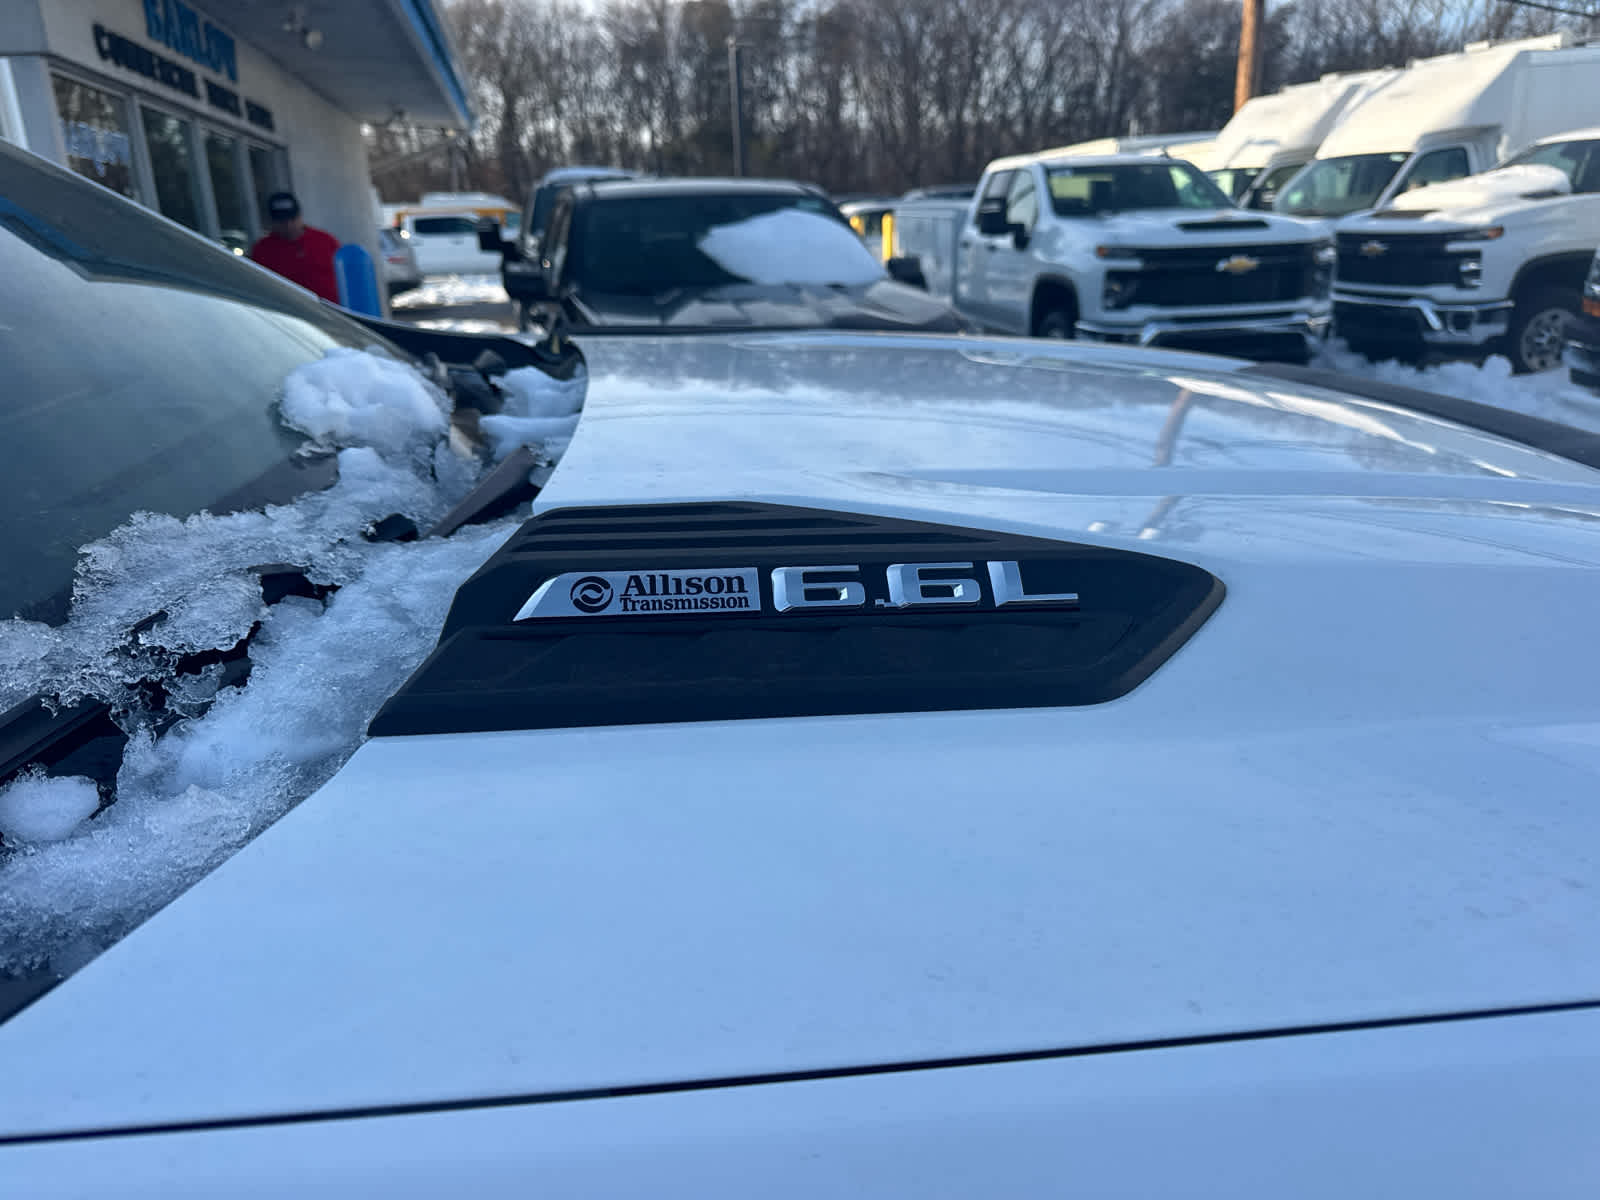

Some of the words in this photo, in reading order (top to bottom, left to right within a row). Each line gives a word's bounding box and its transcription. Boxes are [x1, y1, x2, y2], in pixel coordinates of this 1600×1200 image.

[620, 574, 749, 596] Allison
[770, 560, 1079, 612] 6.6L
[620, 597, 749, 612] Transmission
